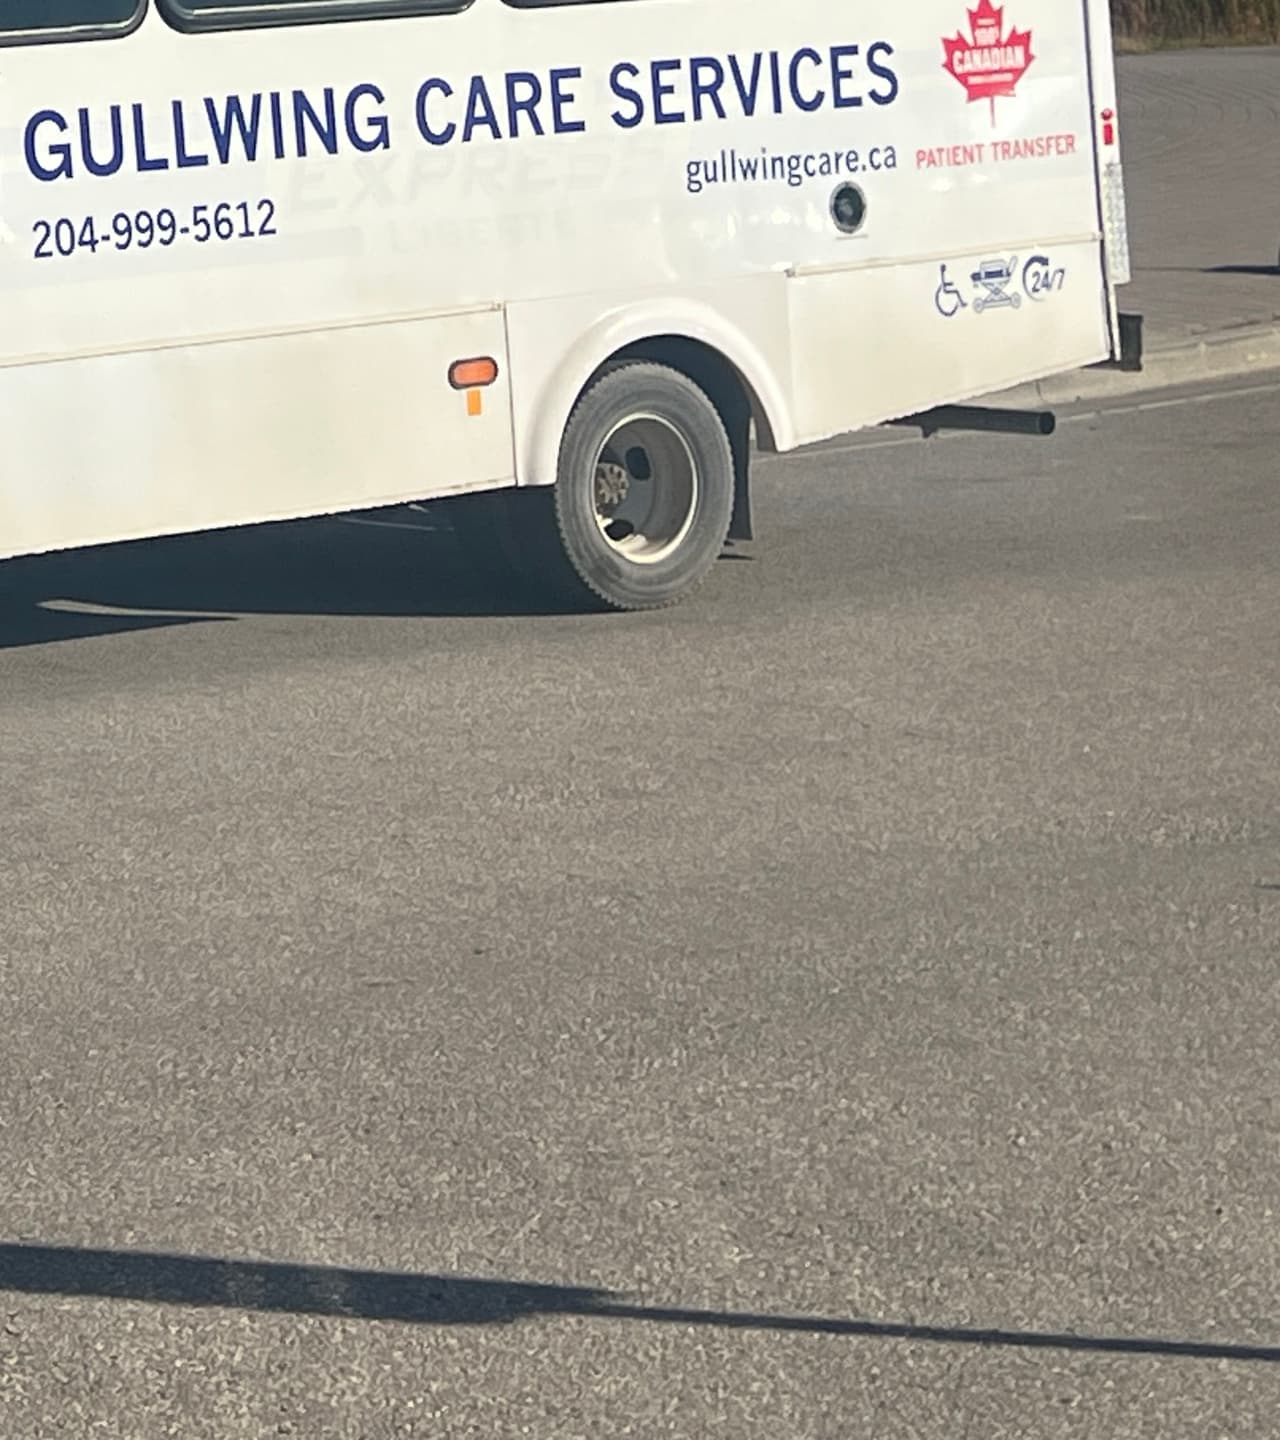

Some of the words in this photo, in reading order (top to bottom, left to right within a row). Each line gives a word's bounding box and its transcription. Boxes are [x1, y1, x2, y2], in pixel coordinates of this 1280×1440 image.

[952, 45, 1025, 73] CANADIAN
[23, 82, 391, 182] GULLWING
[414, 67, 586, 146] CARE
[608, 41, 899, 129] SERVICES
[685, 144, 898, 193] gullwingcare.ca
[915, 141, 984, 171] PATIENT
[990, 133, 1077, 161] TRANSFER
[32, 199, 278, 260] 204-999-5612
[1031, 268, 1066, 293] 24/7
